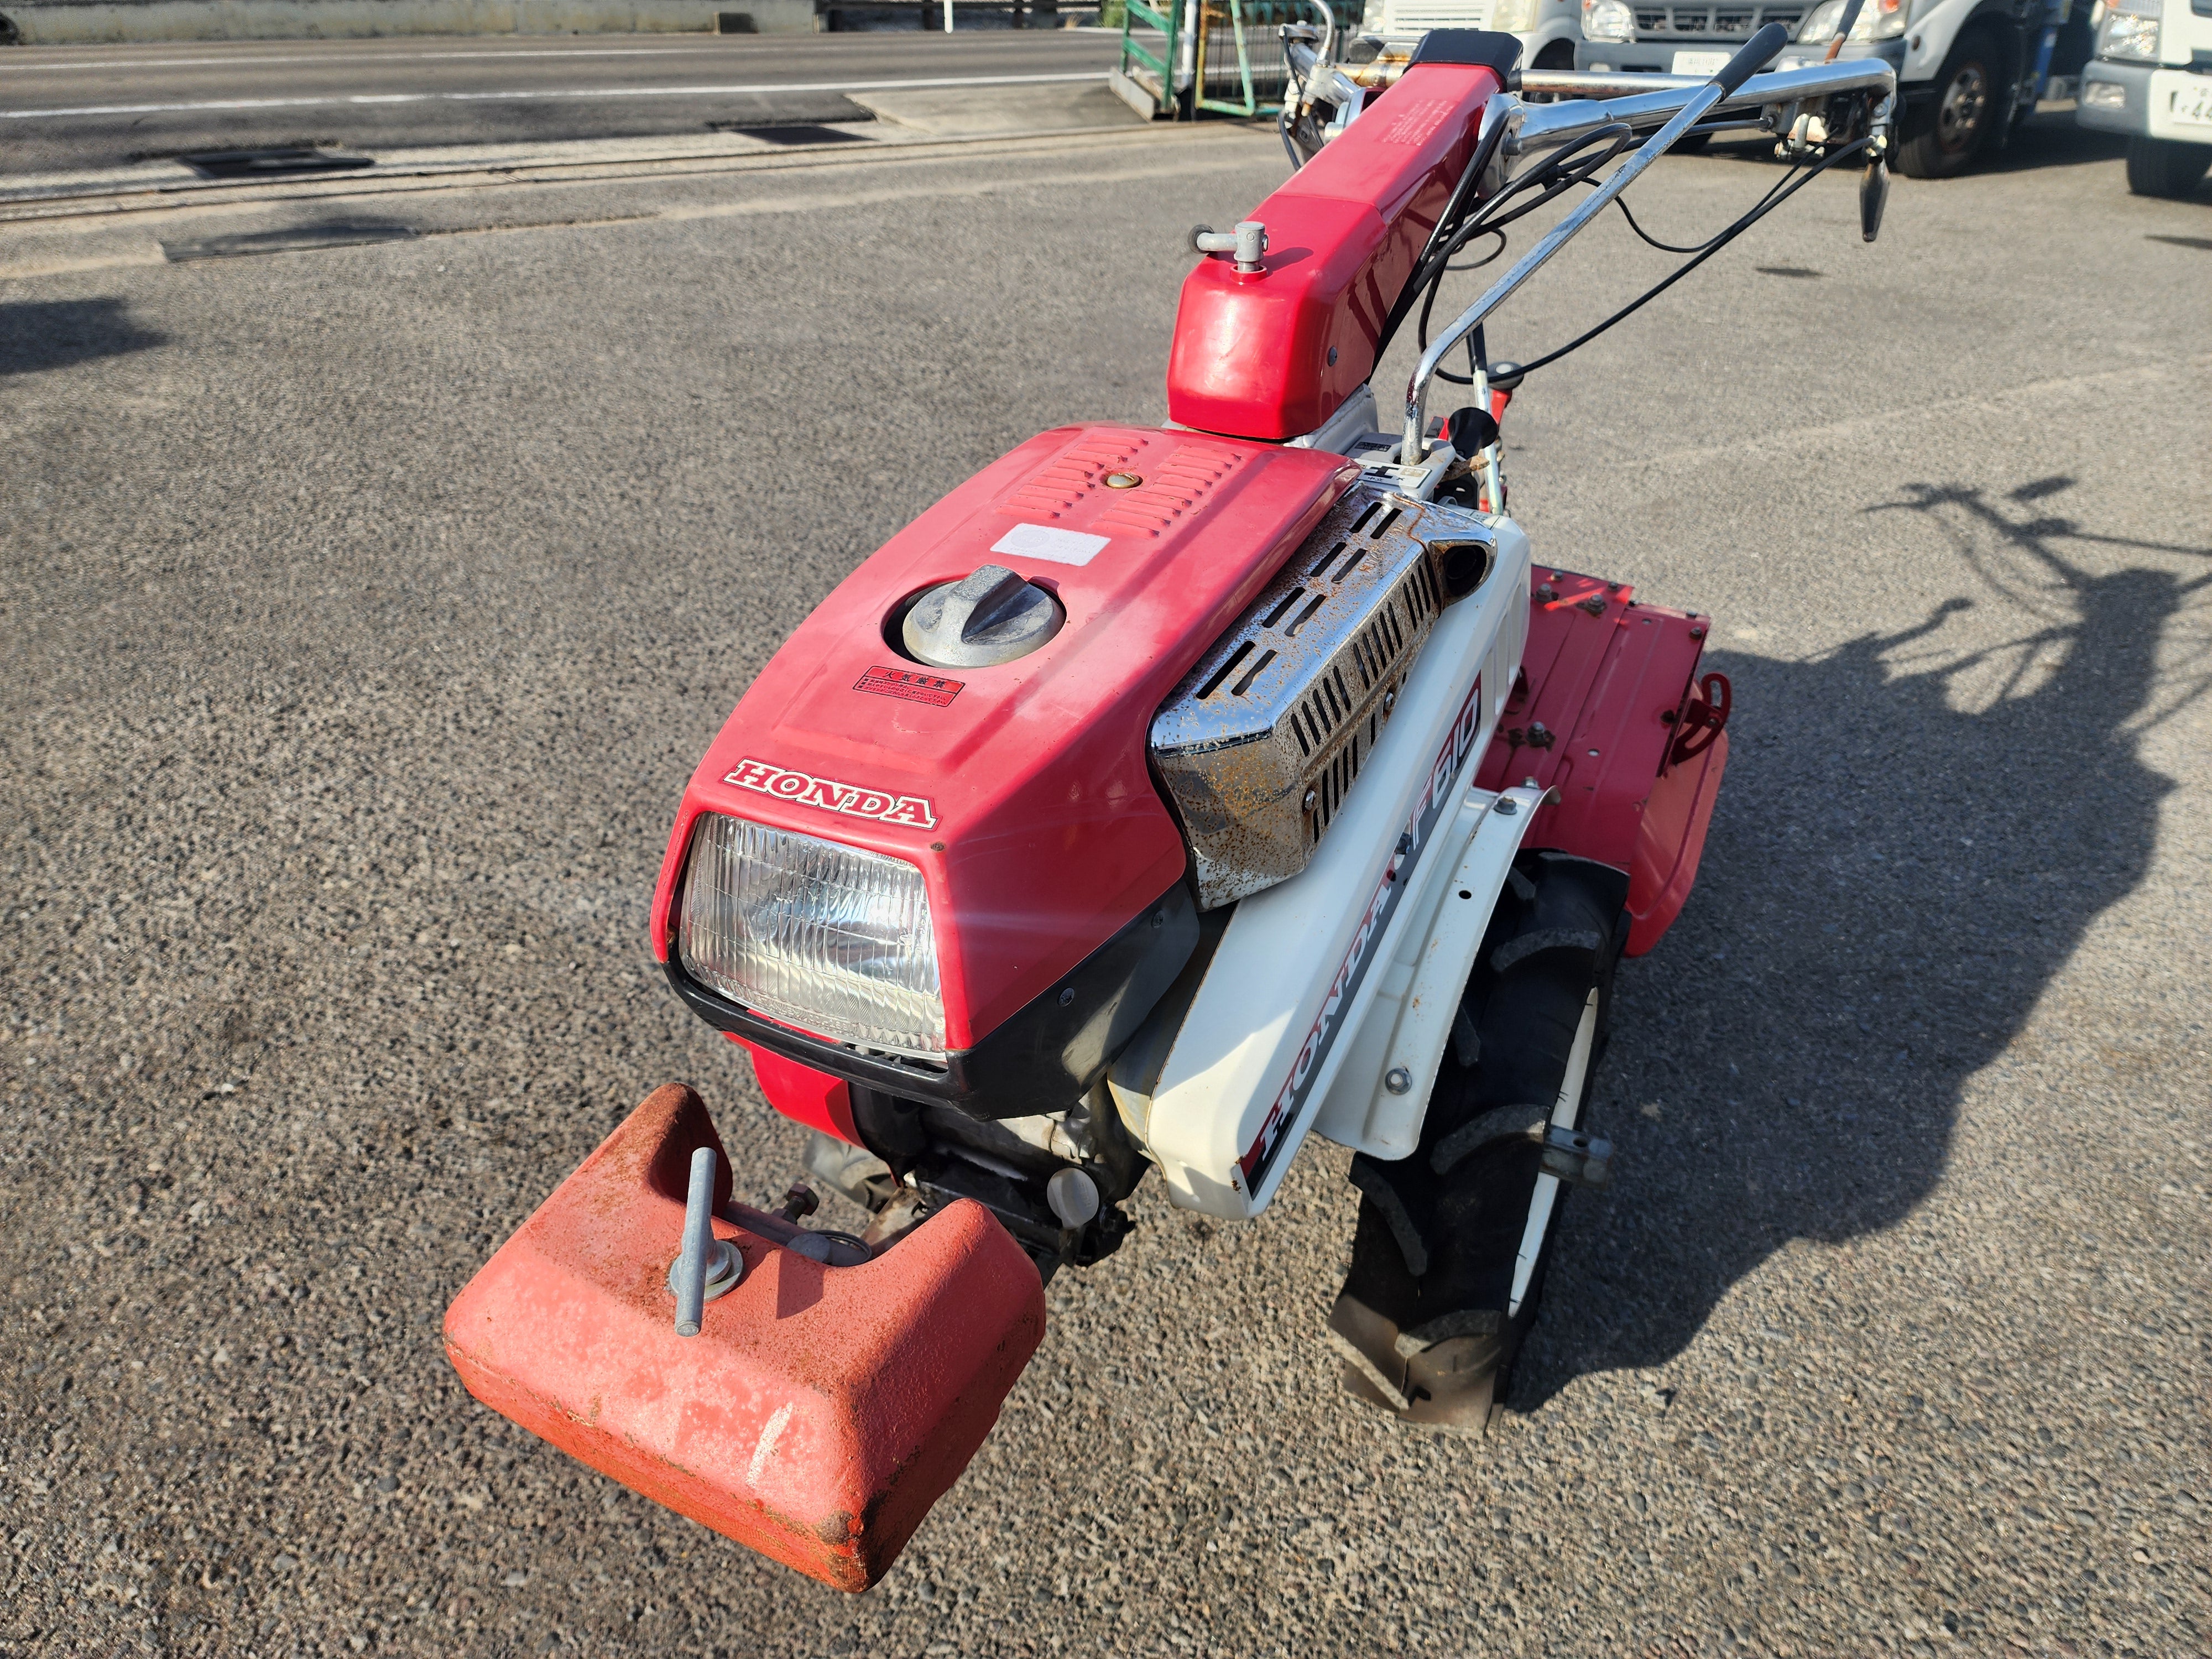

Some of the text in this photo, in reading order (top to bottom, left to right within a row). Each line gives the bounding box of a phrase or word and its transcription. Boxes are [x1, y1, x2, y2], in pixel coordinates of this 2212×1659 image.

[883, 670, 947, 689] 火気厳禁
[724, 759, 938, 828] HONDA
[1258, 878, 1392, 1161] HONDA
